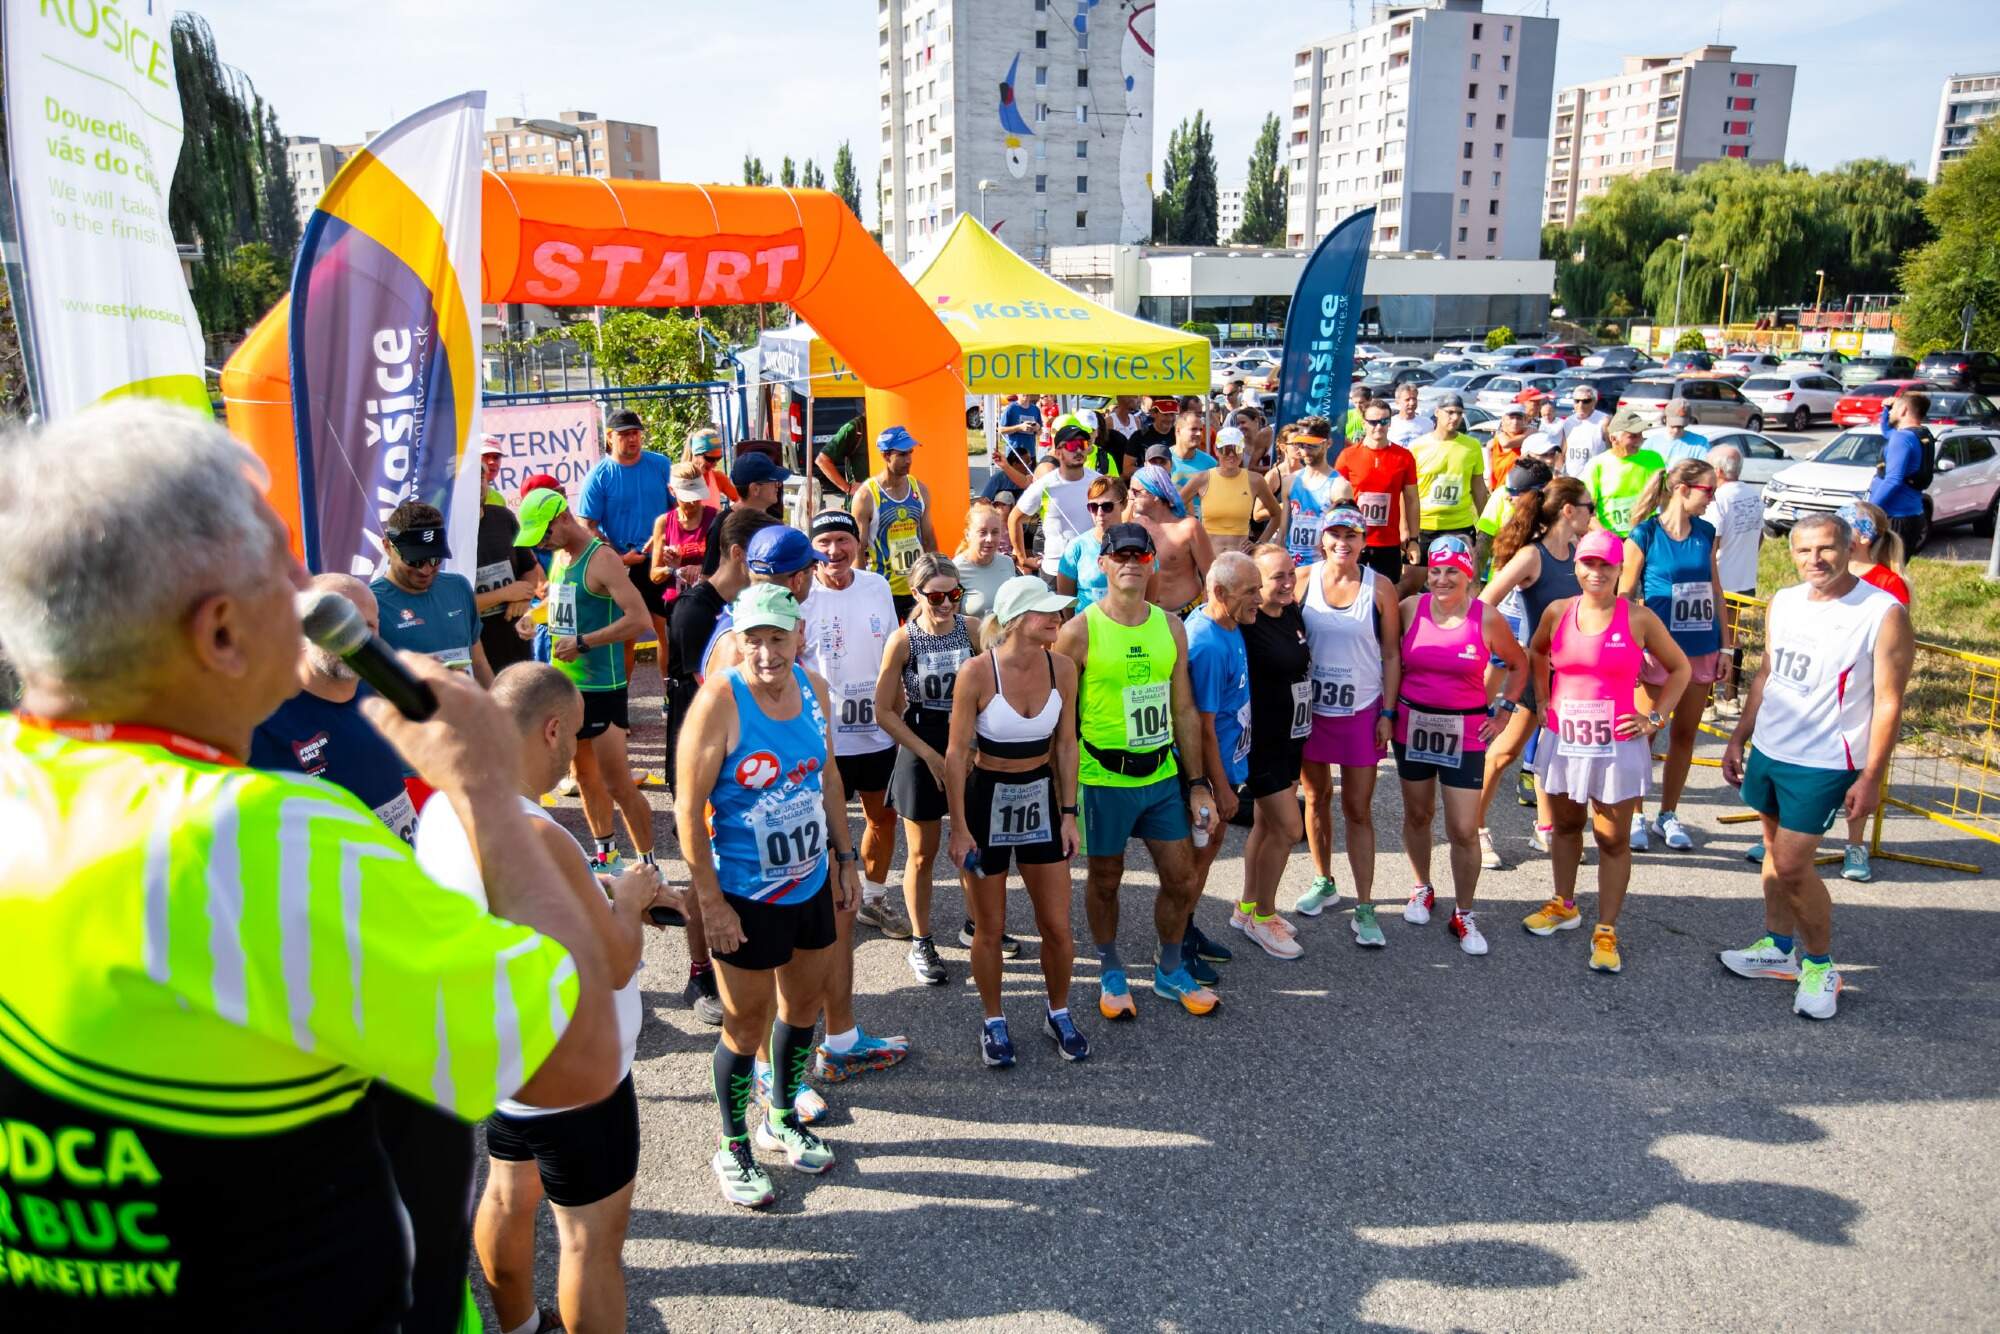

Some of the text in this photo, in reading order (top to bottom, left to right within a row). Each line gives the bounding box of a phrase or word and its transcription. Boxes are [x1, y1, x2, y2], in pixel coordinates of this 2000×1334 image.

[47, 135, 86, 166] vás
[95, 148, 128, 175] do
[49, 176, 77, 201] We
[84, 189, 113, 209] will
[73, 212, 104, 236] the
[525, 241, 799, 303] START
[973, 300, 1090, 321] Košice
[1569, 447, 1589, 460] 059
[488, 456, 590, 491] RATÓN
[1434, 485, 1458, 499] 047
[1361, 504, 1387, 520] 001
[1293, 527, 1316, 545] 037
[551, 602, 574, 628] 044
[1675, 598, 1712, 621] 046
[1775, 647, 1811, 681] 113
[1311, 679, 1356, 707] 036
[842, 698, 875, 725] 06
[1131, 704, 1168, 737] 104
[1413, 728, 1459, 756] 007
[1562, 719, 1612, 746] 035
[998, 802, 1041, 833] 116
[767, 821, 821, 866] 012
[19, 1194, 170, 1250] BUC
